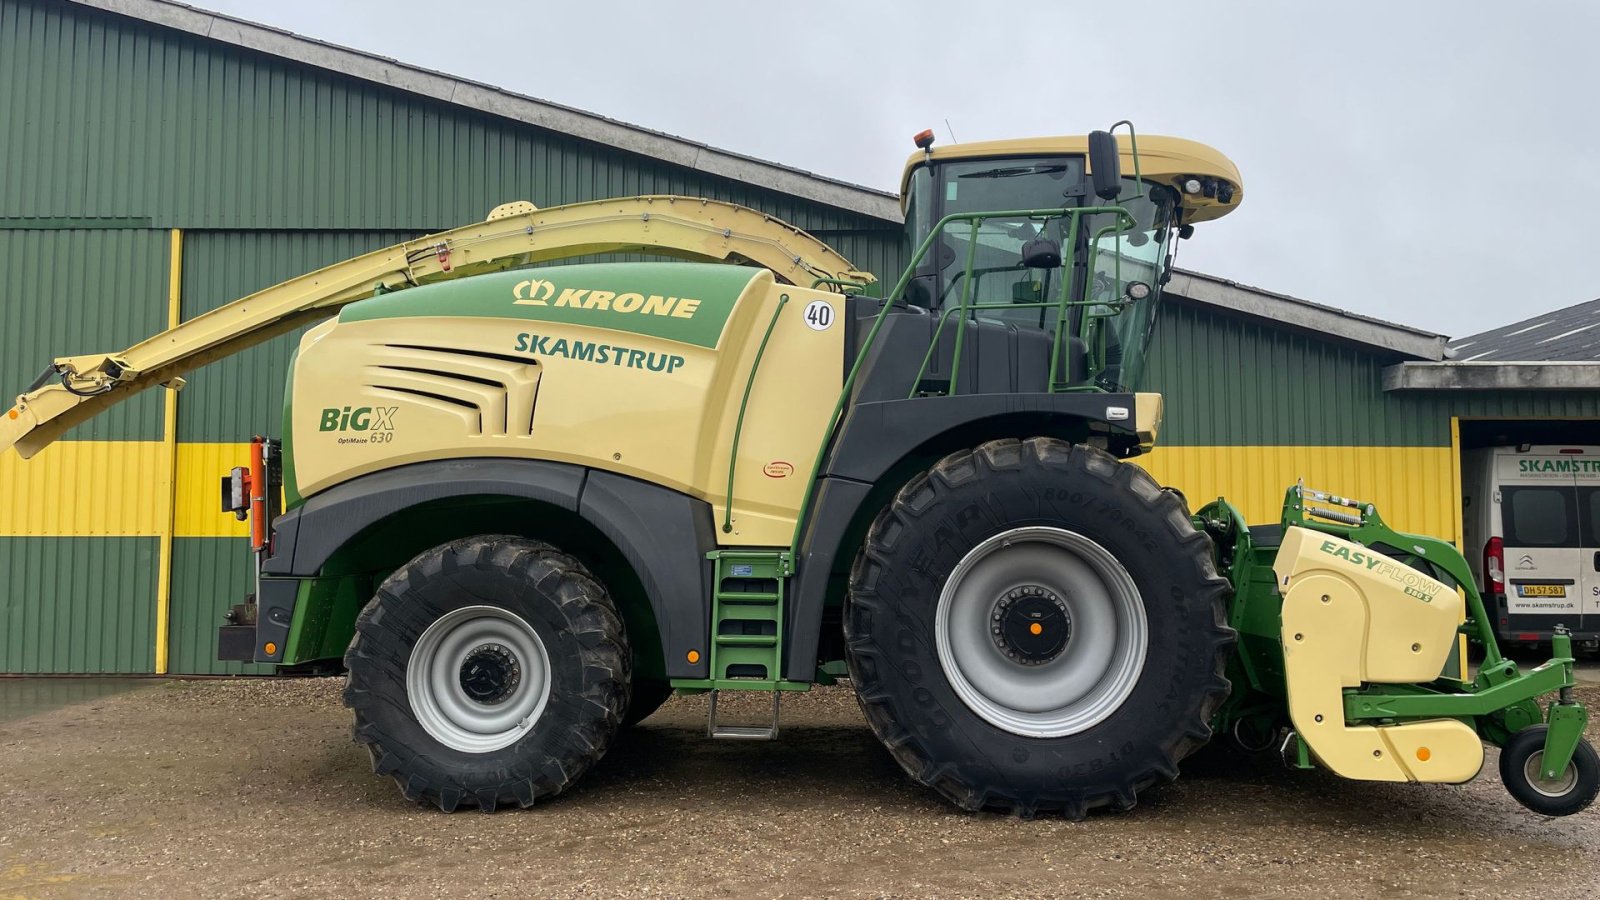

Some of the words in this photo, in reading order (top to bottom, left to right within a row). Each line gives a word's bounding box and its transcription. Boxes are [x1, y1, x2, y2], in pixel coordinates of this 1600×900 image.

[553, 288, 702, 319] KRONE
[806, 304, 831, 326] 40
[514, 332, 685, 374] SKAMSTRUP
[370, 432, 393, 443] 630
[1405, 587, 1424, 599] 380
[1537, 586, 1546, 594] 57
[1548, 586, 1563, 594] 587
